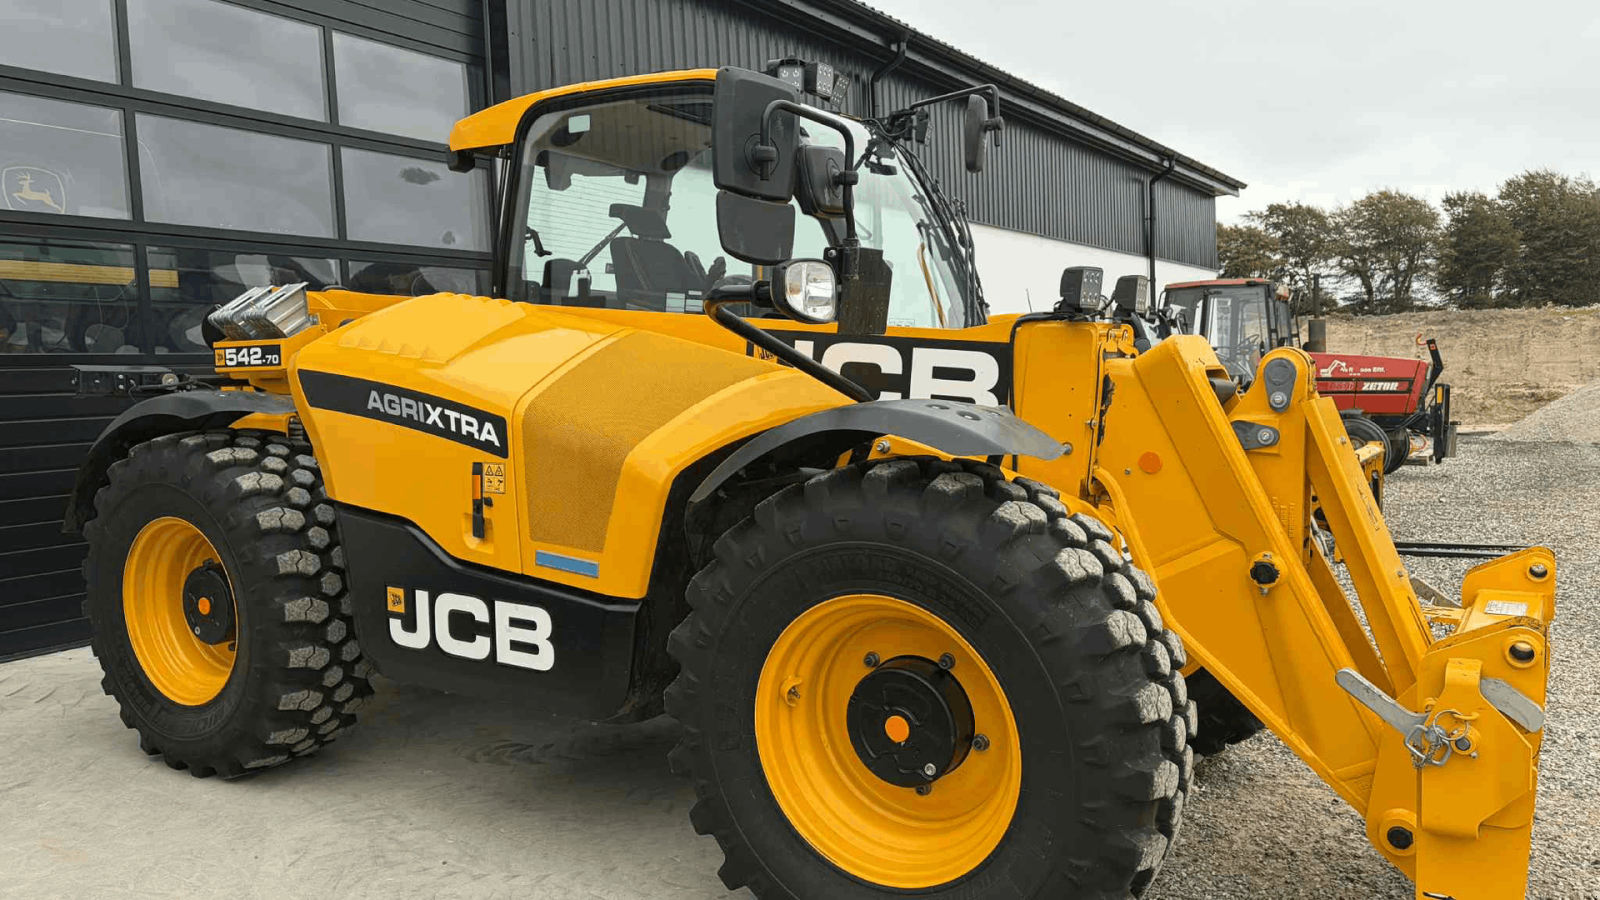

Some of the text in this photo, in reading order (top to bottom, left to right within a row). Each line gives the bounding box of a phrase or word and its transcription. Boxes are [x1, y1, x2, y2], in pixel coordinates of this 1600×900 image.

[794, 340, 999, 406] CB
[1362, 382, 1399, 391] ZETOR
[367, 390, 500, 447] AGRIXTRA
[389, 589, 555, 671] JCB
